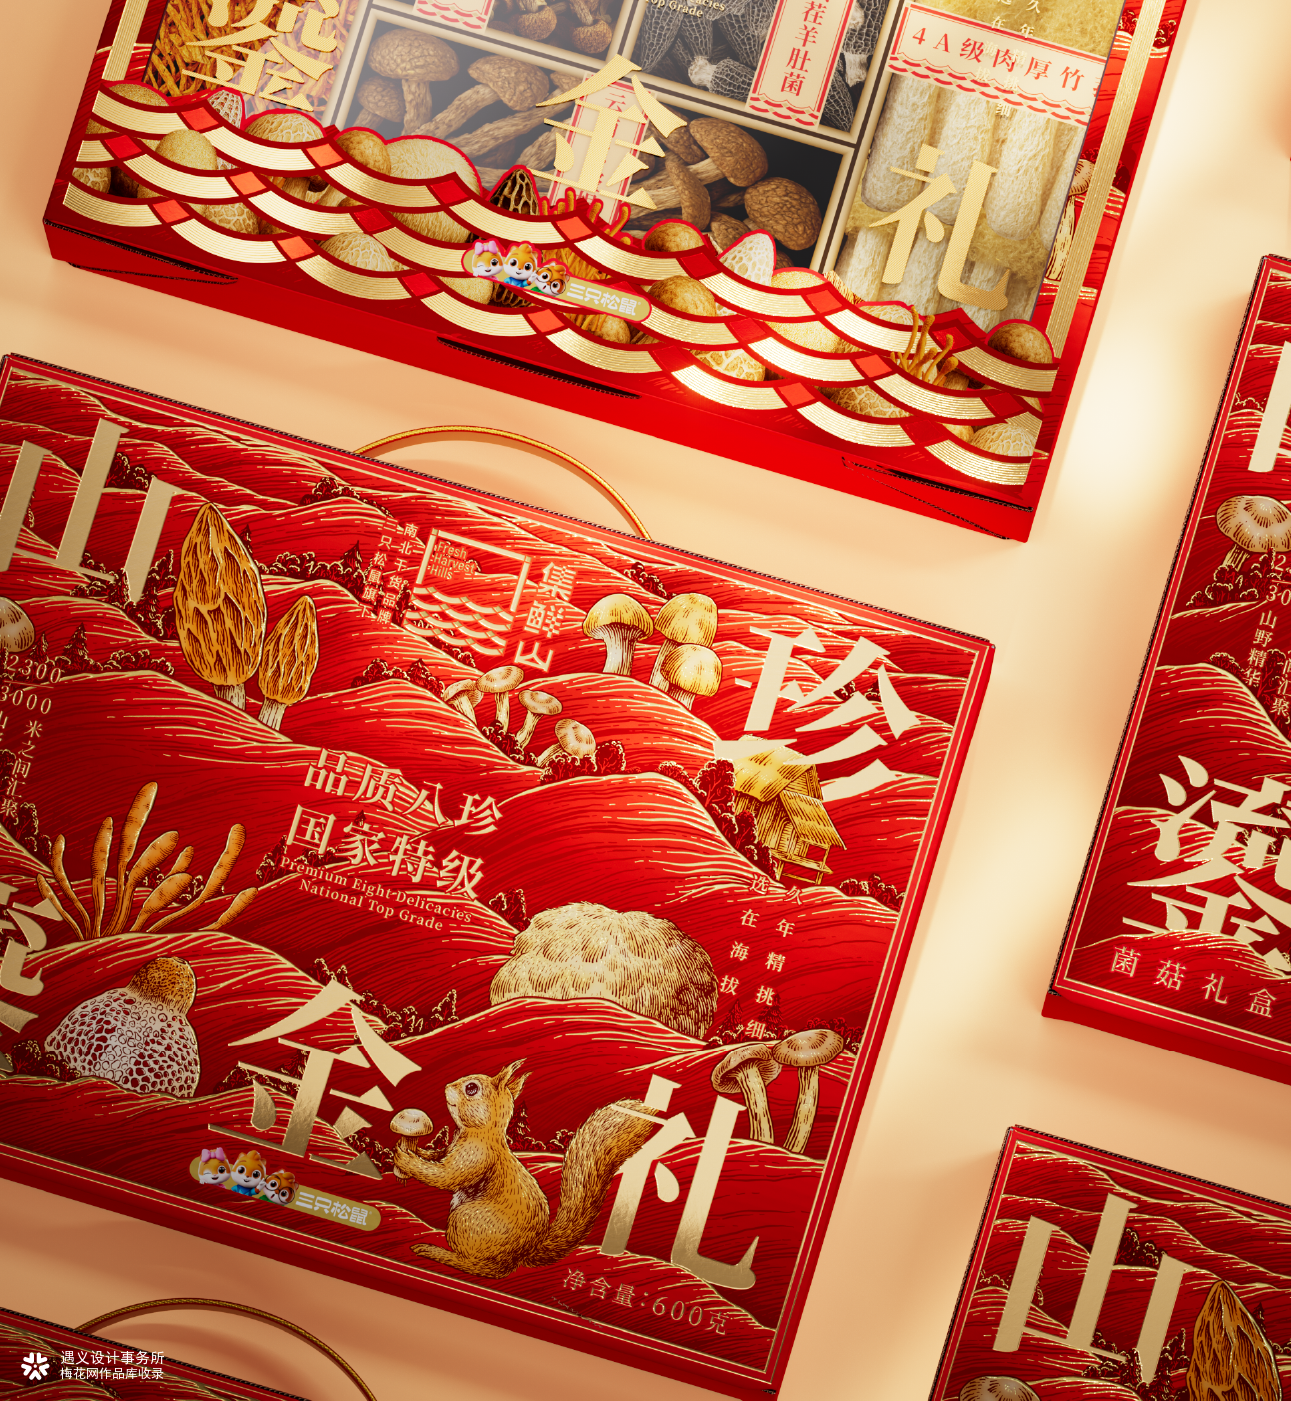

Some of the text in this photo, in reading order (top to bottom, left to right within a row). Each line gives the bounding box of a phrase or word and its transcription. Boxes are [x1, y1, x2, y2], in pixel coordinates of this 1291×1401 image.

[668, 0, 704, 18] Grade
[912, 27, 1100, 98] 4A级肉厚竹
[527, 53, 688, 211] 金
[868, 143, 1010, 311] 礼
[565, 282, 637, 317] 三只松鼠
[0, 417, 182, 604] 山
[430, 563, 454, 581] Hills
[432, 553, 477, 575] Harvest
[435, 540, 468, 559] Fresh
[7, 654, 62, 684] 2300
[714, 625, 921, 801] 珍
[304, 747, 503, 836] 品质八珍
[286, 804, 485, 901] 国家特级
[279, 856, 473, 924] Premium Eight Delicacies
[298, 878, 444, 932] National Top Grade
[1109, 944, 1277, 1019] 菌菇礼盒
[206, 979, 423, 1181] 金
[294, 1191, 369, 1227] 三只松鼠
[600, 1073, 760, 1290] 礼
[992, 1192, 1196, 1387] 山
